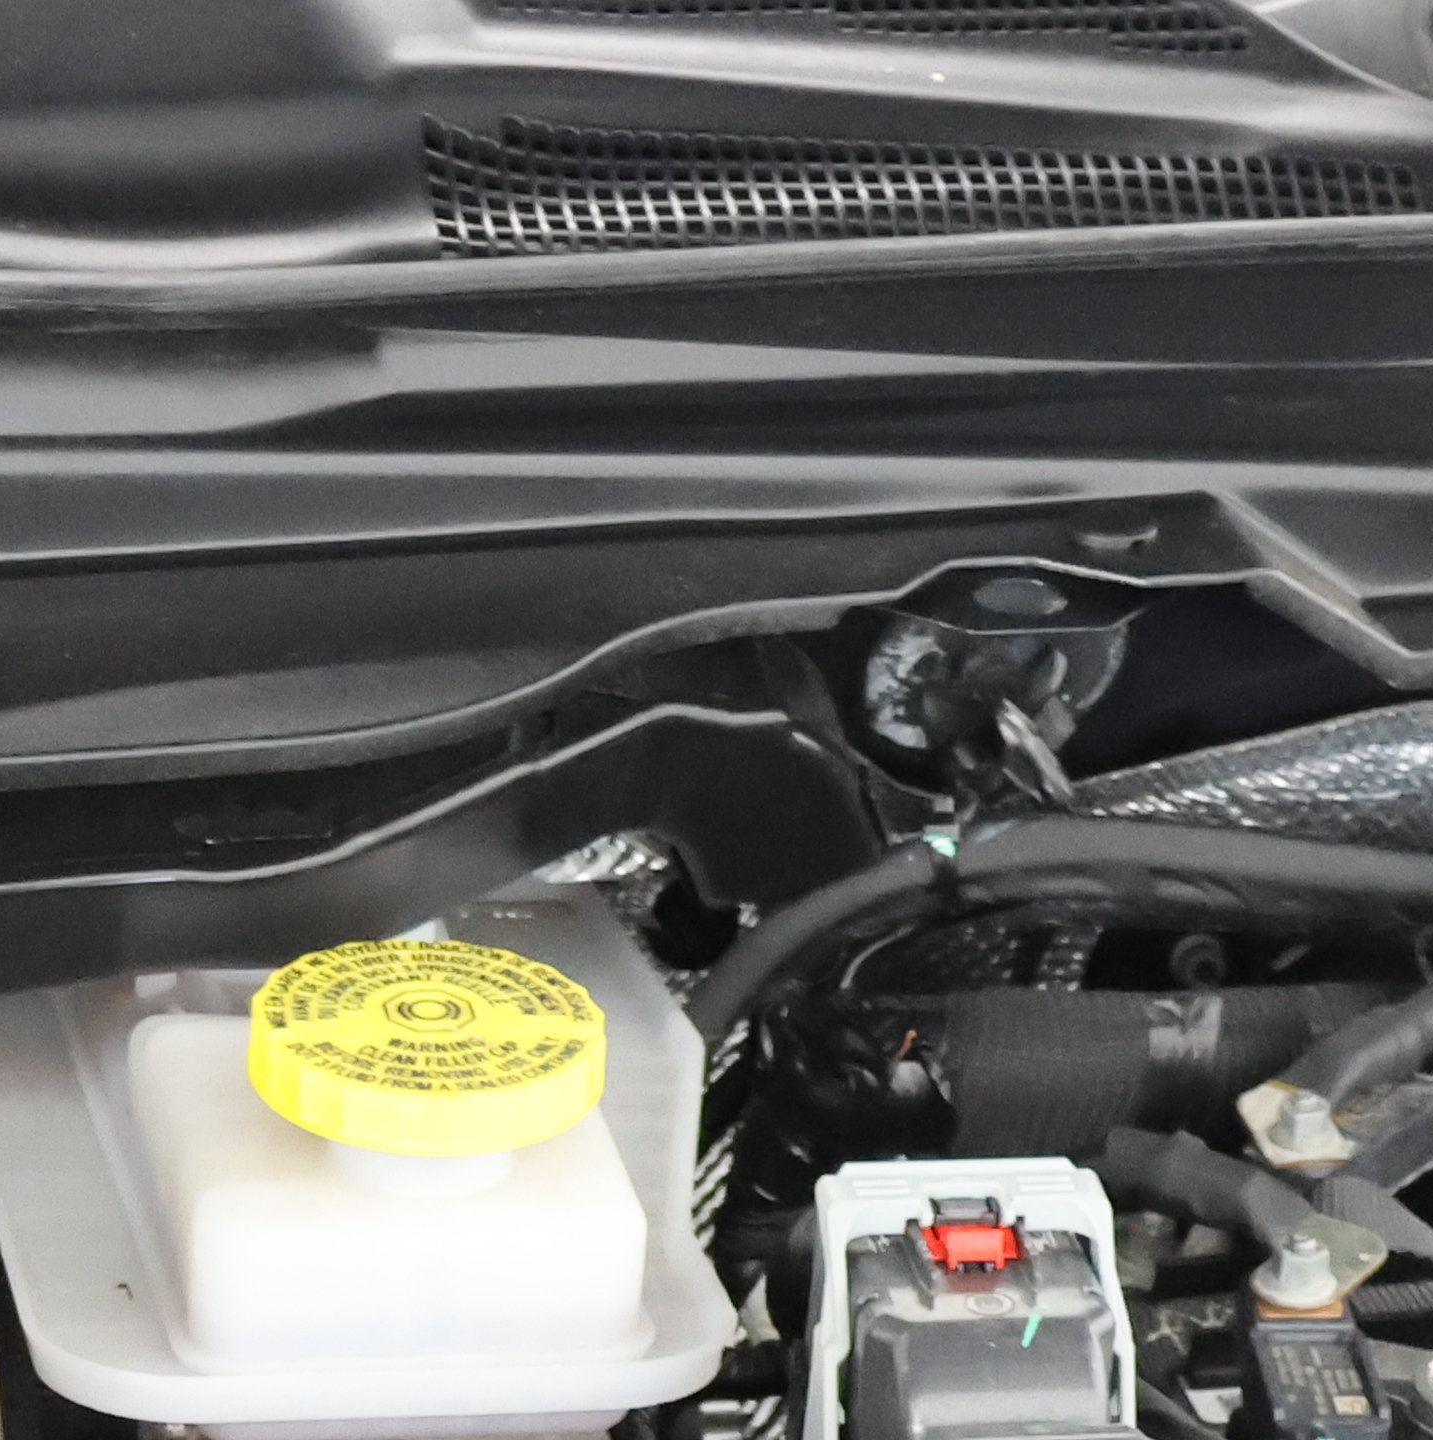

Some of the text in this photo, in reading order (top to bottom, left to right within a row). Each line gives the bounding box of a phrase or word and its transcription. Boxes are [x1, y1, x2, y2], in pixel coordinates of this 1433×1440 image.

[358, 1045, 417, 1066] CLEAN
[424, 1051, 488, 1067] FILLER
[380, 1077, 432, 1091] FROM
[439, 1082, 451, 1092] A
